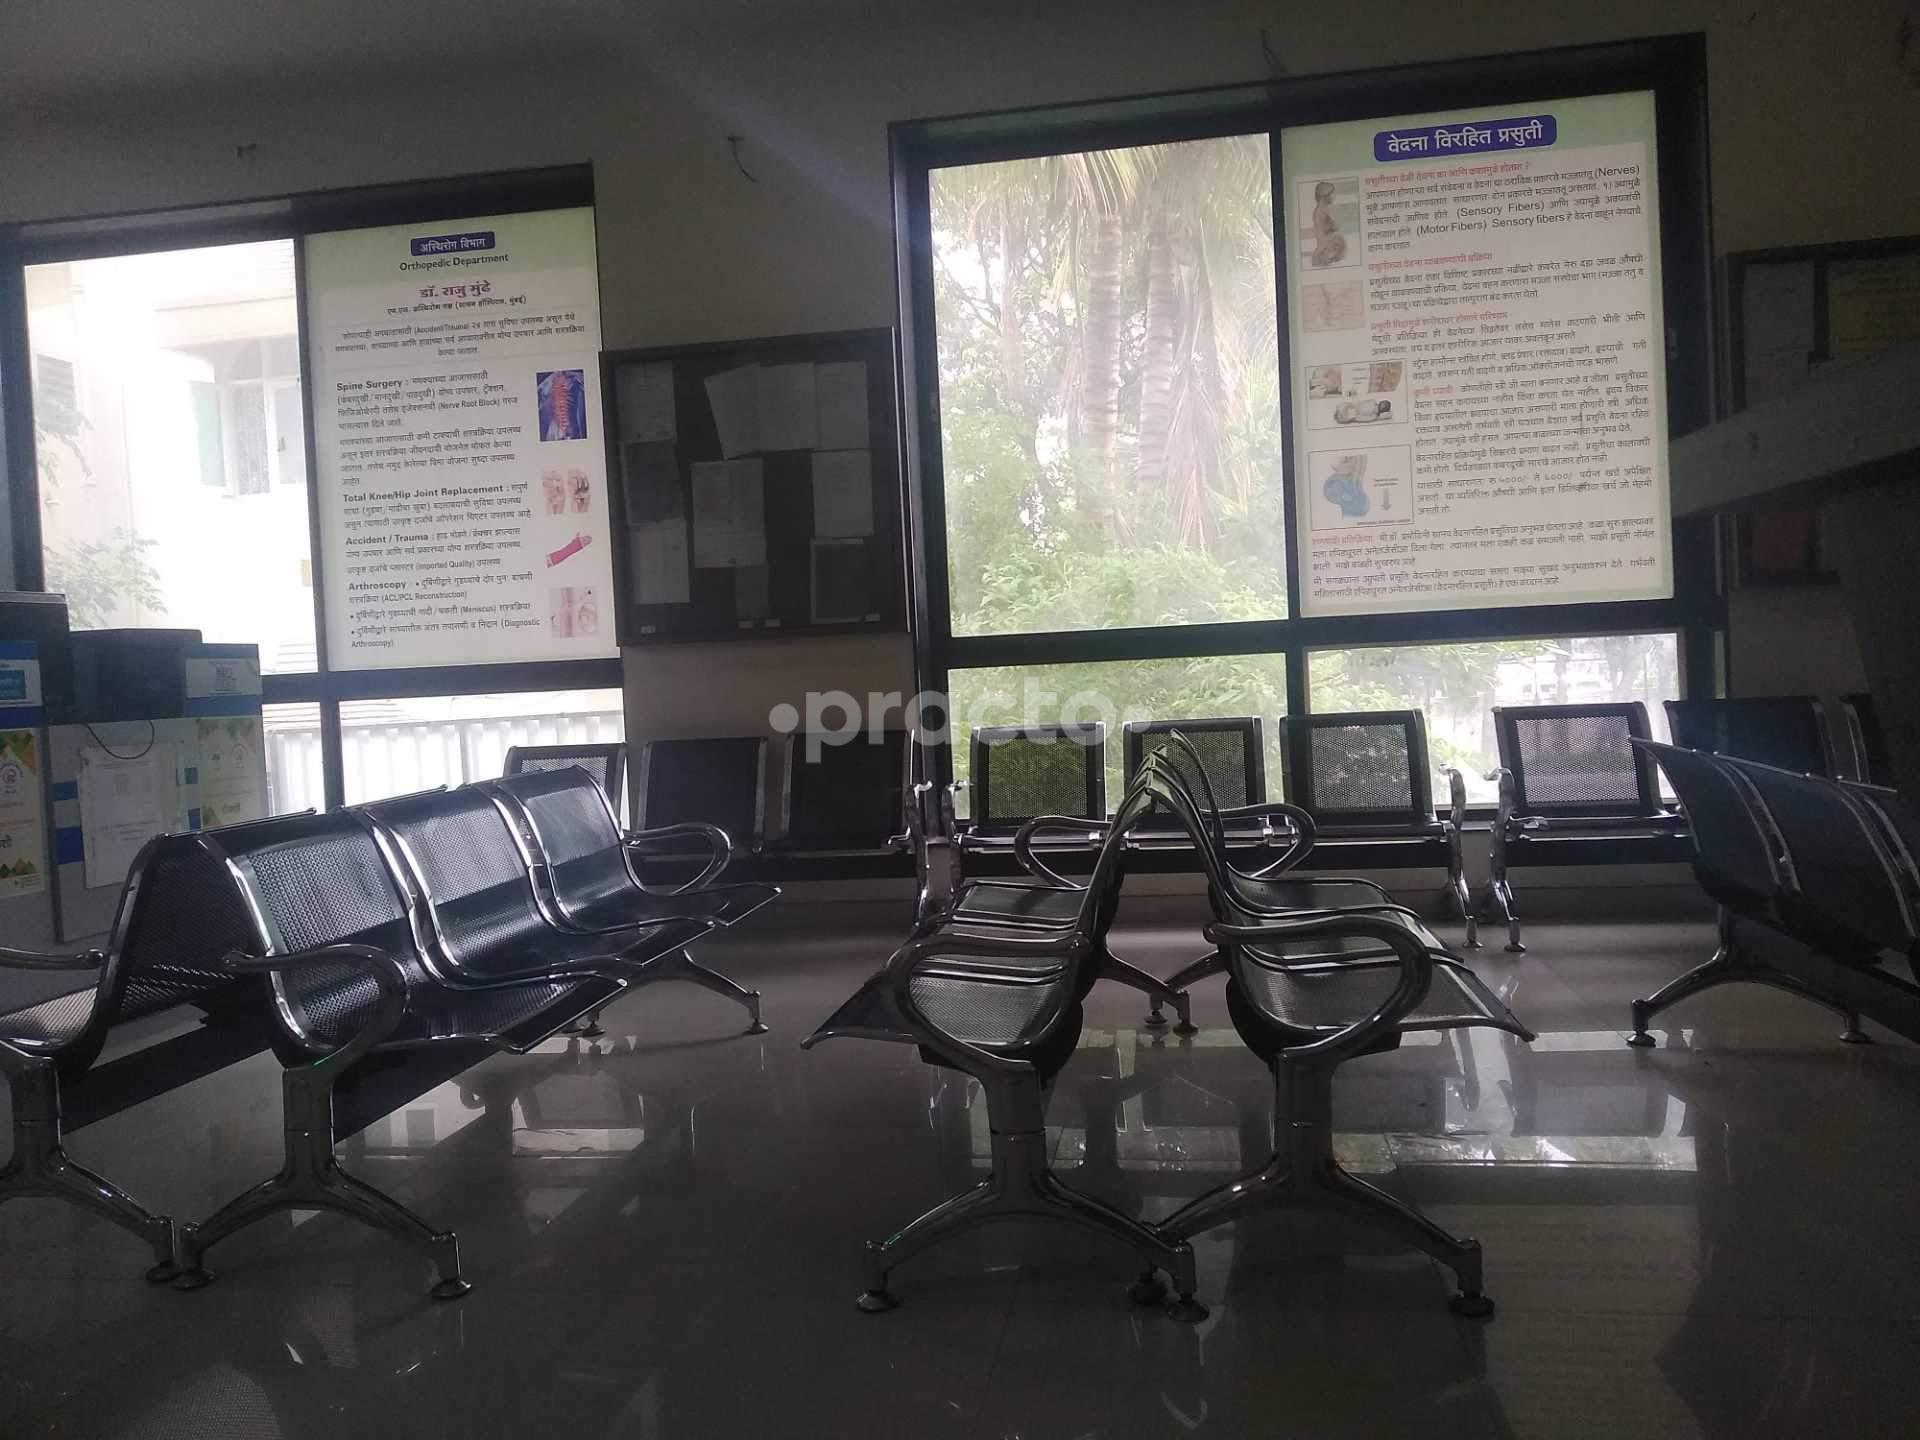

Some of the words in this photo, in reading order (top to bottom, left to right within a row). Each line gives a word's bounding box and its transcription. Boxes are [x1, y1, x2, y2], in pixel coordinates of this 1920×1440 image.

[1387, 134, 1428, 154] वेदना
[1435, 127, 1491, 150] विरहित
[1498, 120, 1543, 146] प्रसुती
[1594, 164, 1639, 178] (Nerves)
[1456, 204, 1502, 218] (Sensory
[1508, 200, 1544, 213] Fibers)
[1416, 223, 1449, 236] (Motor
[1450, 219, 1486, 233] Fibers)
[1491, 215, 1534, 229] Sensory
[1536, 212, 1564, 223] fibers
[421, 239, 456, 252] अस्थिरोग
[461, 237, 485, 249] विभाग
[400, 260, 451, 271] Orthopedic
[453, 254, 509, 266] Department
[420, 285, 438, 297] डॉ.
[336, 382, 362, 392] Spine
[365, 378, 402, 390] Surgery
[438, 400, 459, 410] (Nerve
[461, 399, 477, 408] Root
[478, 397, 499, 407] Block)
[343, 493, 366, 502] Total
[369, 490, 410, 502] Knee/Hip
[414, 488, 438, 498] Joint
[440, 483, 503, 497] Replacement
[345, 535, 385, 545] Accident
[395, 532, 428, 542] Trauma
[415, 561, 447, 571] (Imported
[448, 559, 474, 569] Quality)
[348, 580, 406, 592] Arthroscopy
[381, 592, 413, 602] (ACL/PCL
[415, 589, 467, 601] Reconstruction)
[500, 617, 540, 628] (Diagnostic
[351, 638, 393, 649] Arthroscopy)
